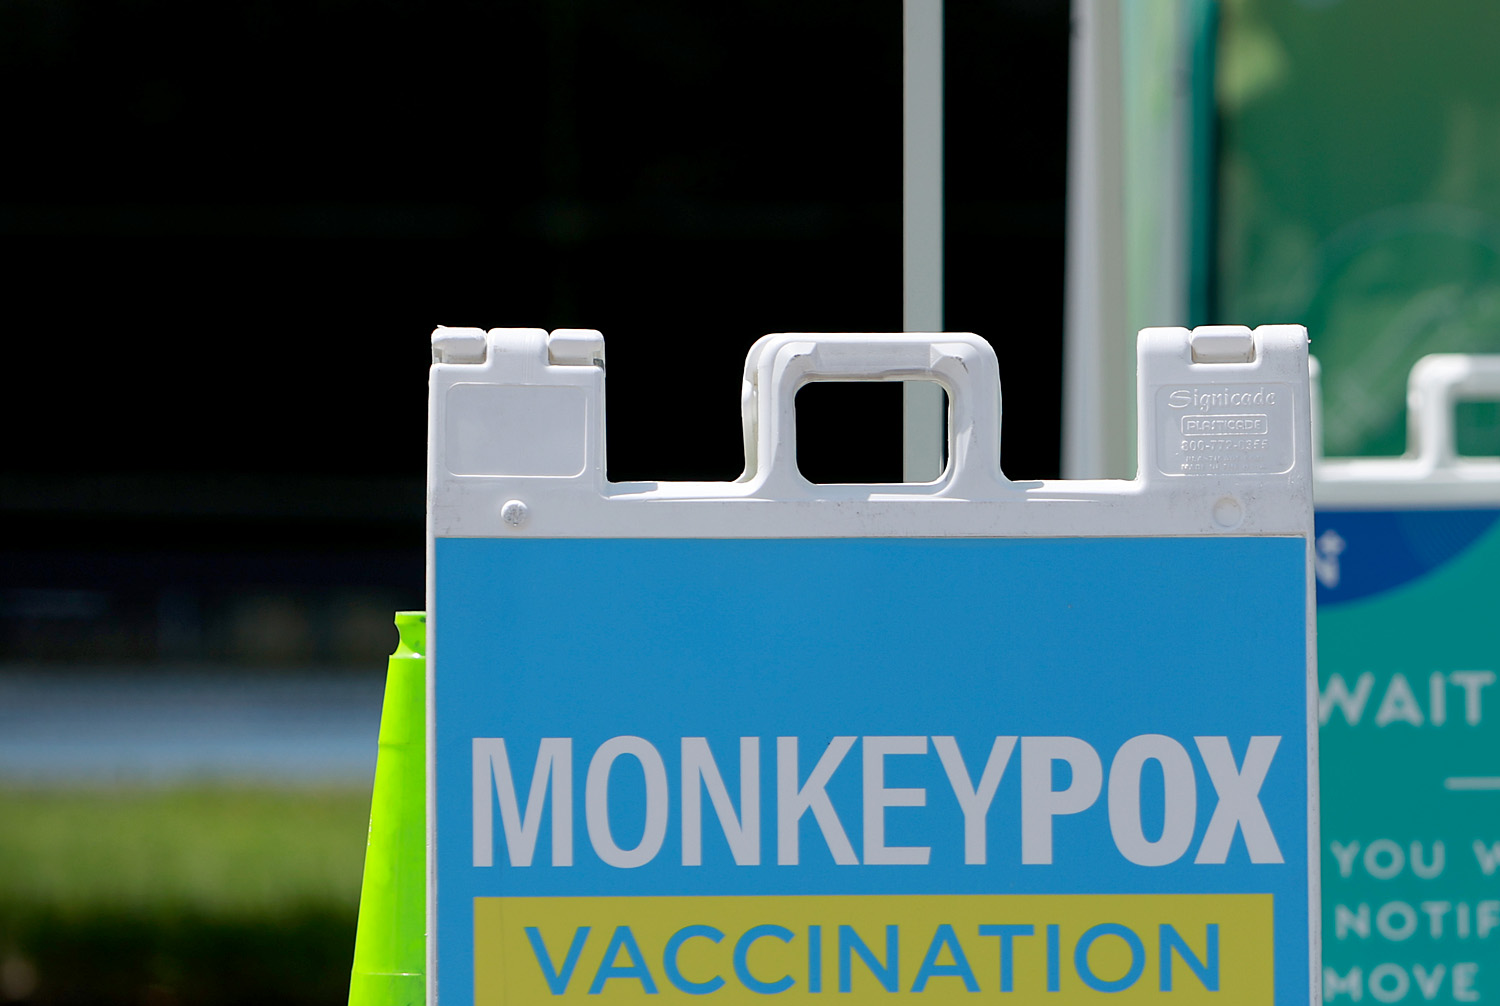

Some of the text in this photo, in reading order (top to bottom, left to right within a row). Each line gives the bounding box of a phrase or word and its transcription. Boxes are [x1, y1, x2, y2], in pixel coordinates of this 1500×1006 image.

[1168, 387, 1277, 412] Signicade
[1319, 671, 1495, 727] WAIT
[471, 733, 1285, 869] MONKEYPOX
[1331, 838, 1445, 880] YOU
[525, 923, 1220, 996] VACCINATION
[1322, 962, 1480, 1003] MOVE
